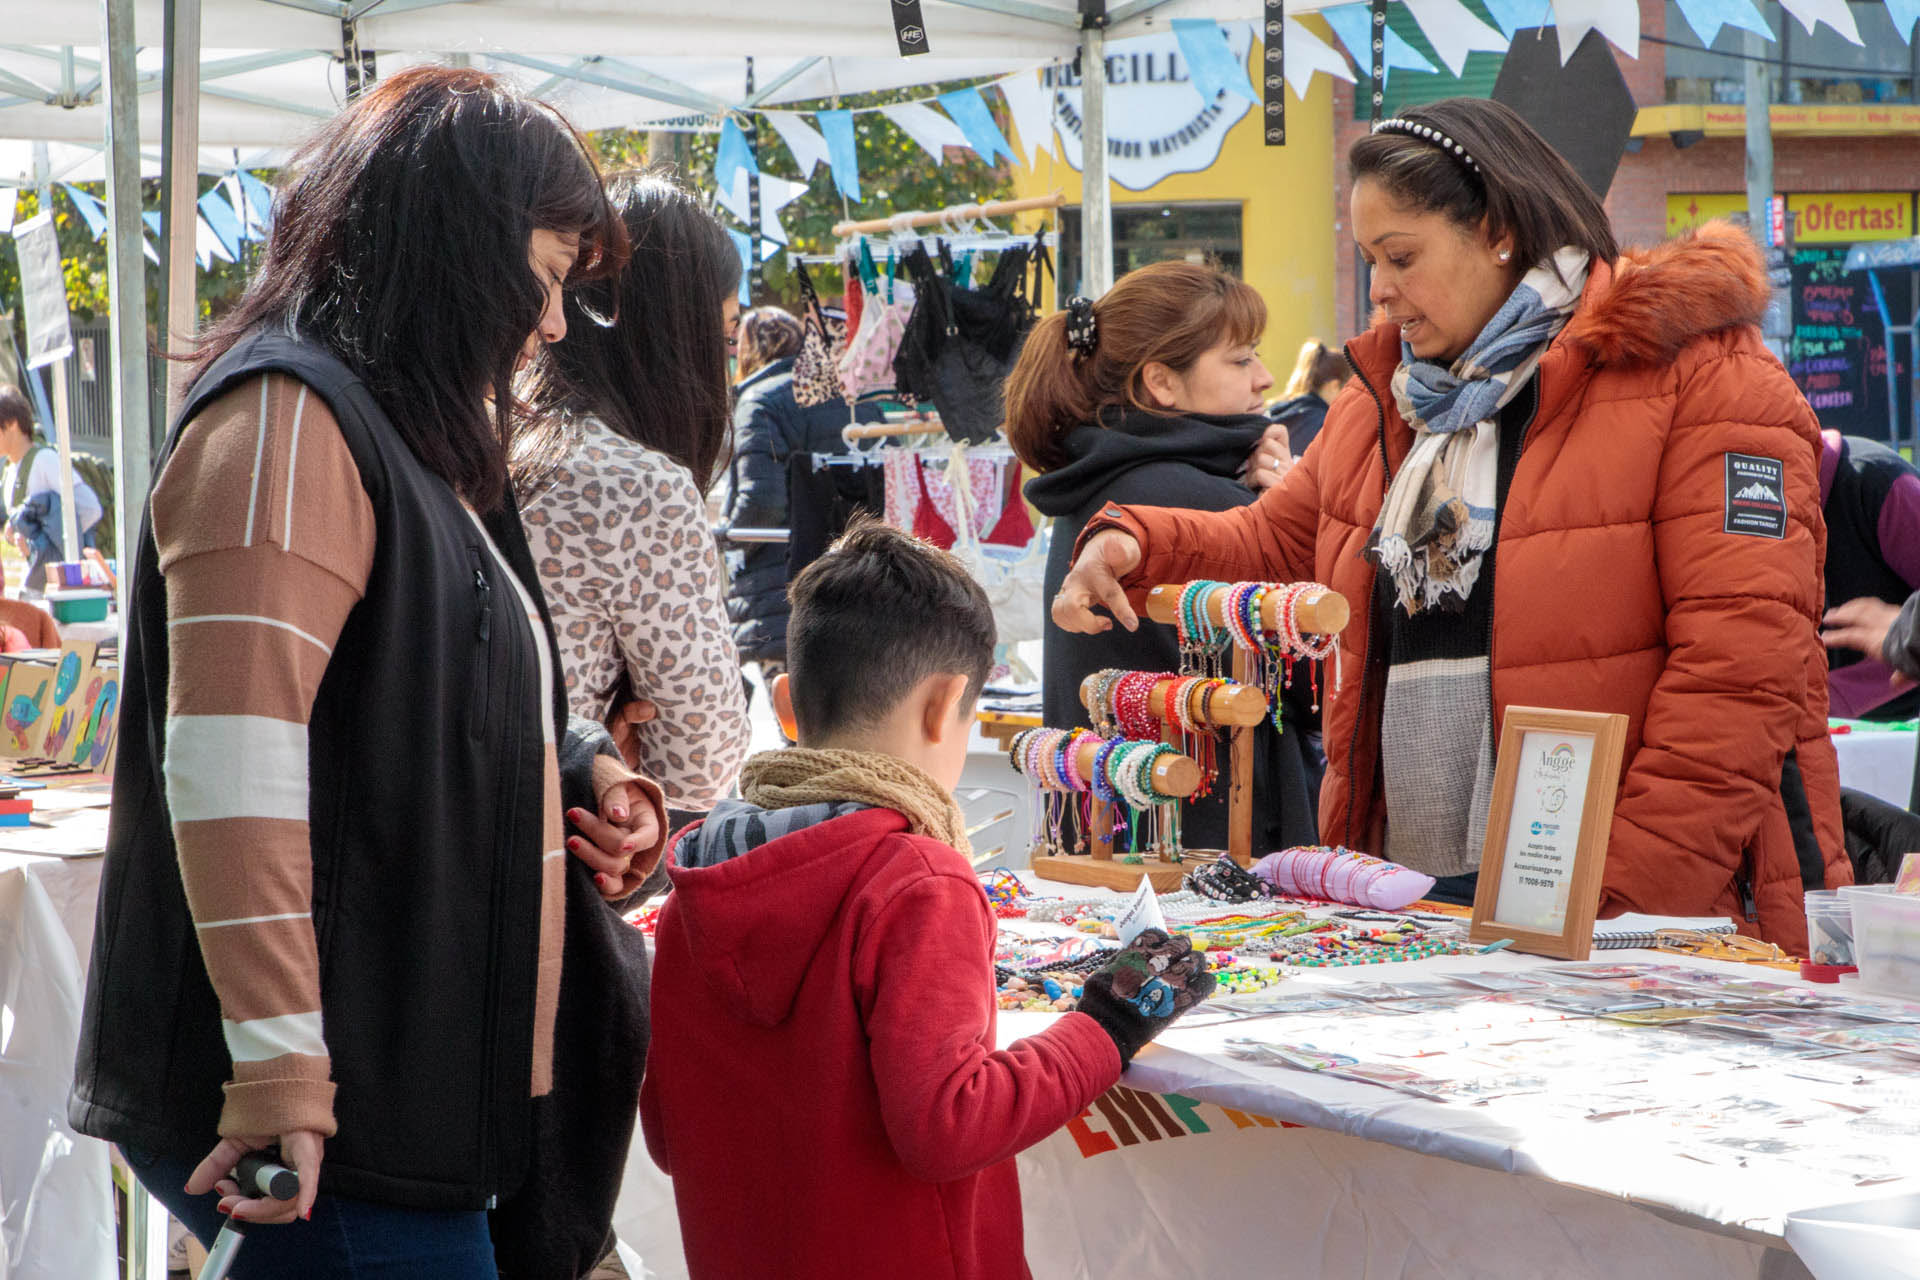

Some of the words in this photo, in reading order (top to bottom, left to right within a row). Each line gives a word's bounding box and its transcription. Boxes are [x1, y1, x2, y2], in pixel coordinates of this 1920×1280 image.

[903, 30, 921, 40] HE
[1796, 202, 1903, 237] ¡Ofertas!
[1734, 461, 1778, 476] QUALITY
